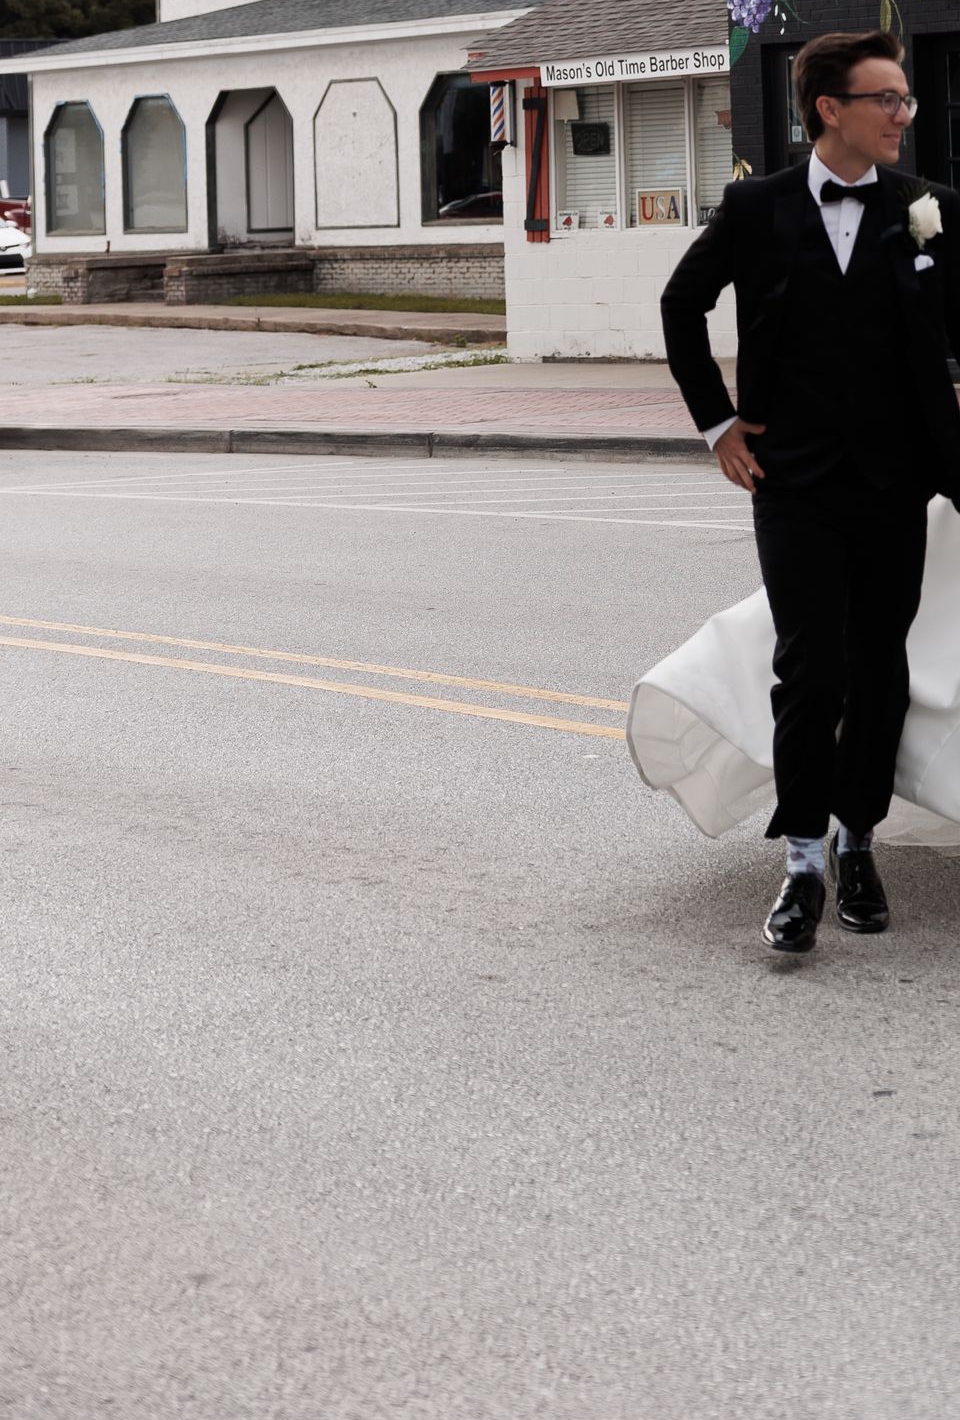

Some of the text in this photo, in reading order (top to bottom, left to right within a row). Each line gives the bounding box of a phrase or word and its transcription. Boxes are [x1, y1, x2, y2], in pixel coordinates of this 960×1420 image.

[546, 52, 725, 81] Mason's Old Time Barber Shop
[640, 196, 681, 221] USA
